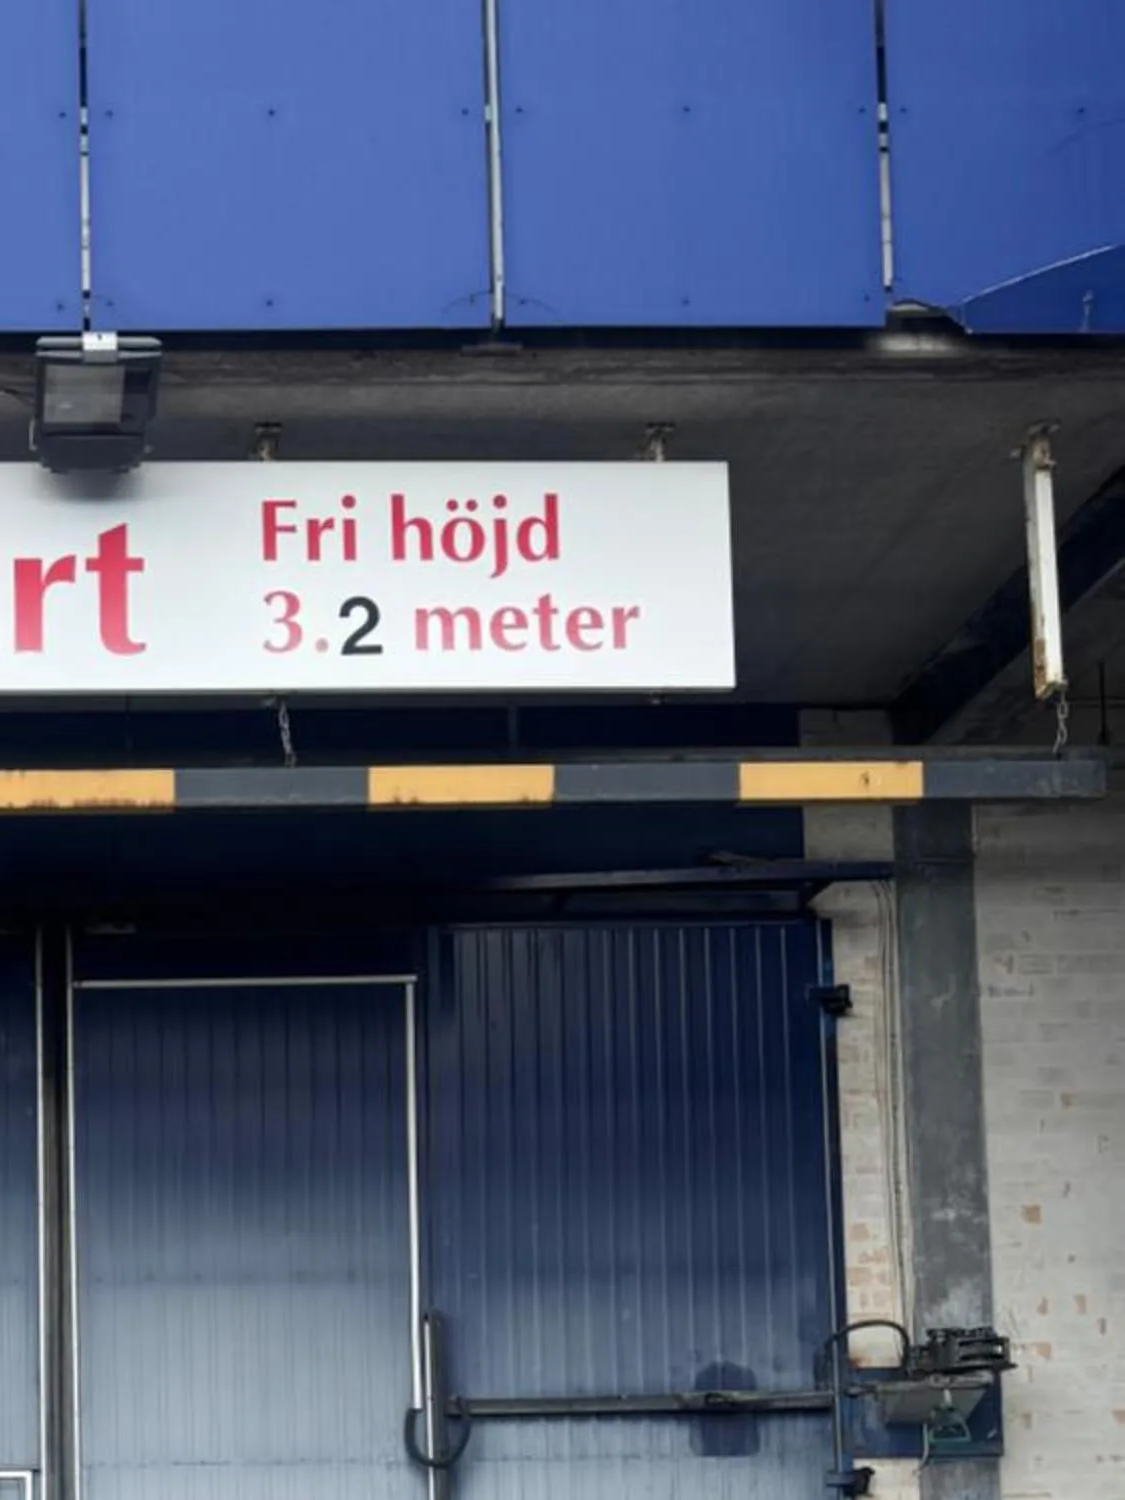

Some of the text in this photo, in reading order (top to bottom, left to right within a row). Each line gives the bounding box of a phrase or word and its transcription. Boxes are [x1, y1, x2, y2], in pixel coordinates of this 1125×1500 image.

[261, 494, 561, 578] Fri höjd
[262, 590, 641, 656] 3.2 meter
